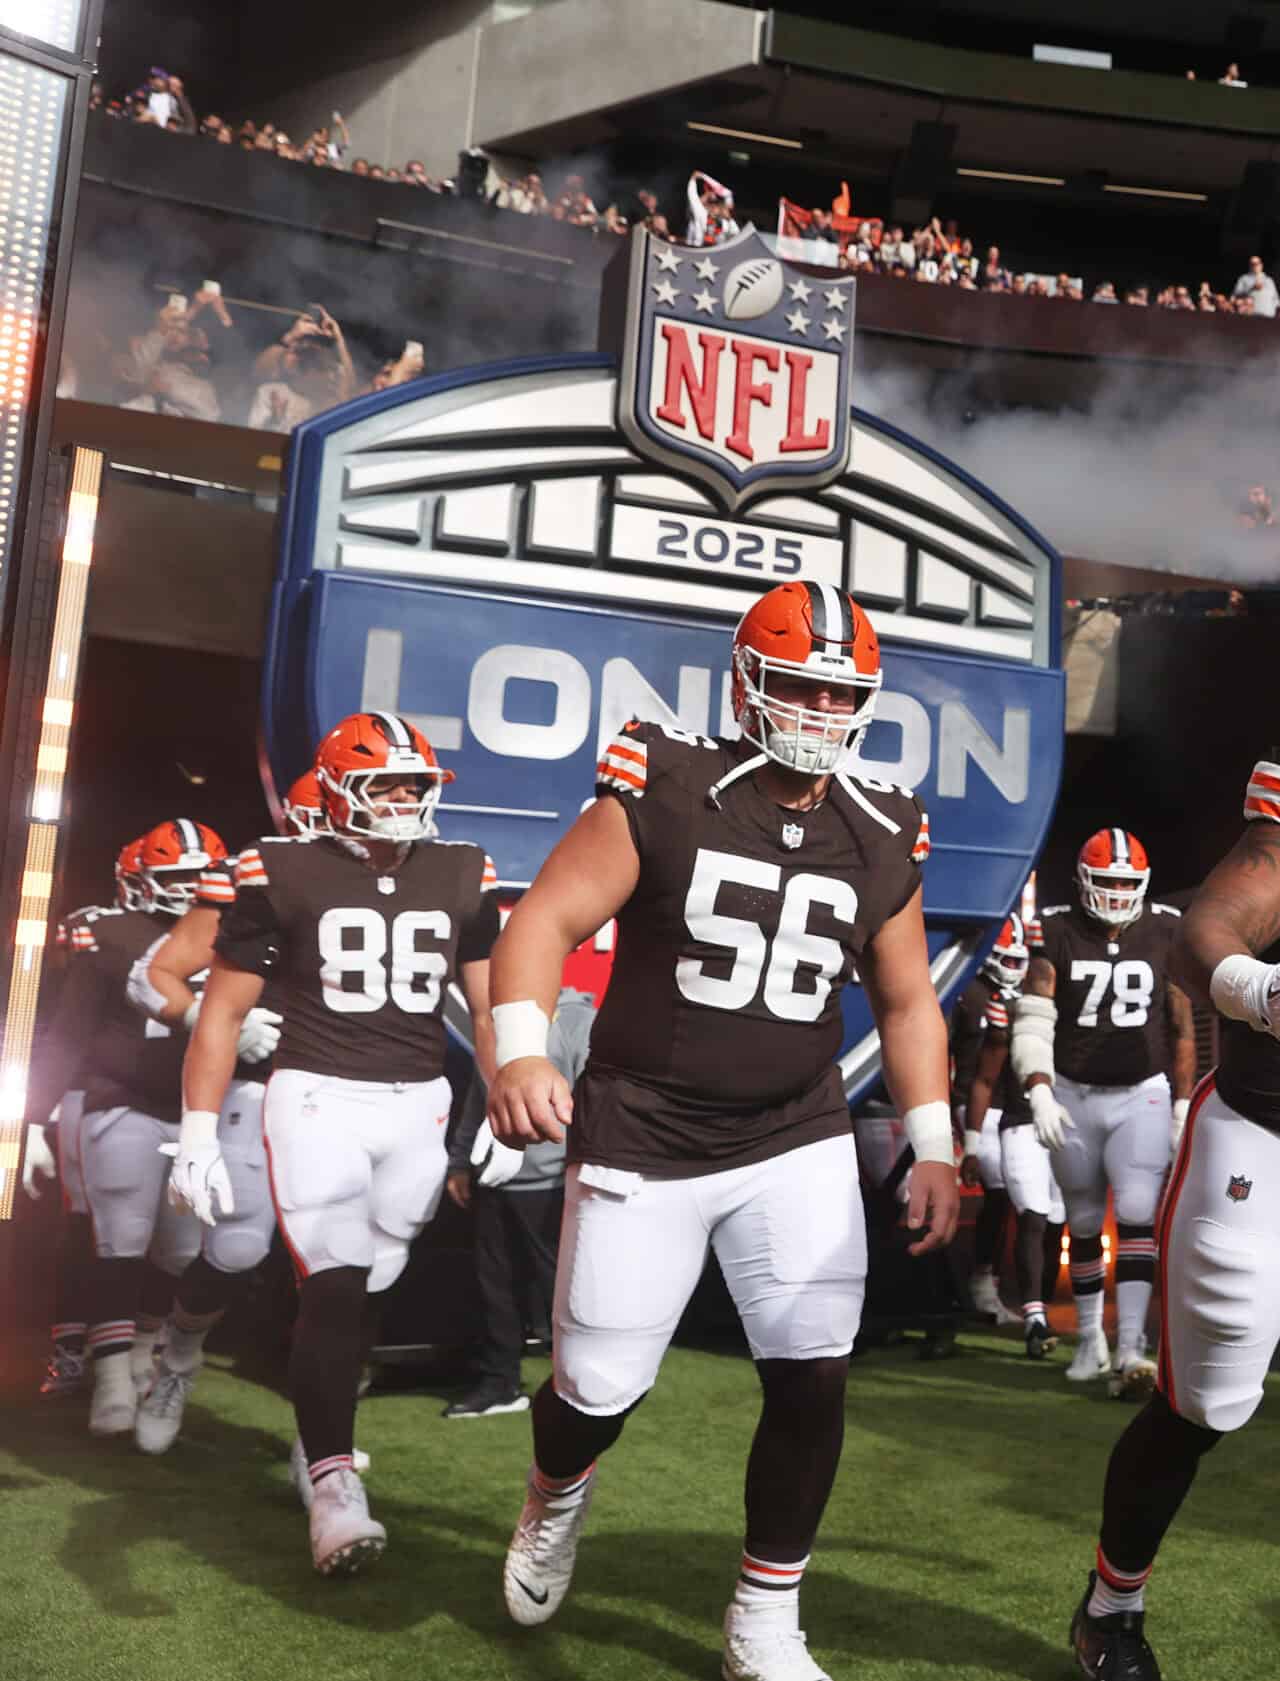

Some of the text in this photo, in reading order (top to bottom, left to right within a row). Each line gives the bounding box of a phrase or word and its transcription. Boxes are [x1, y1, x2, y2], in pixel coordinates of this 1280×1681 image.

[656, 323, 831, 462] NFL
[656, 518, 804, 576] 2025
[361, 627, 1030, 804] LONON
[317, 906, 452, 1014] 86
[674, 847, 859, 1023] 56
[1069, 959, 1155, 1028] 78
